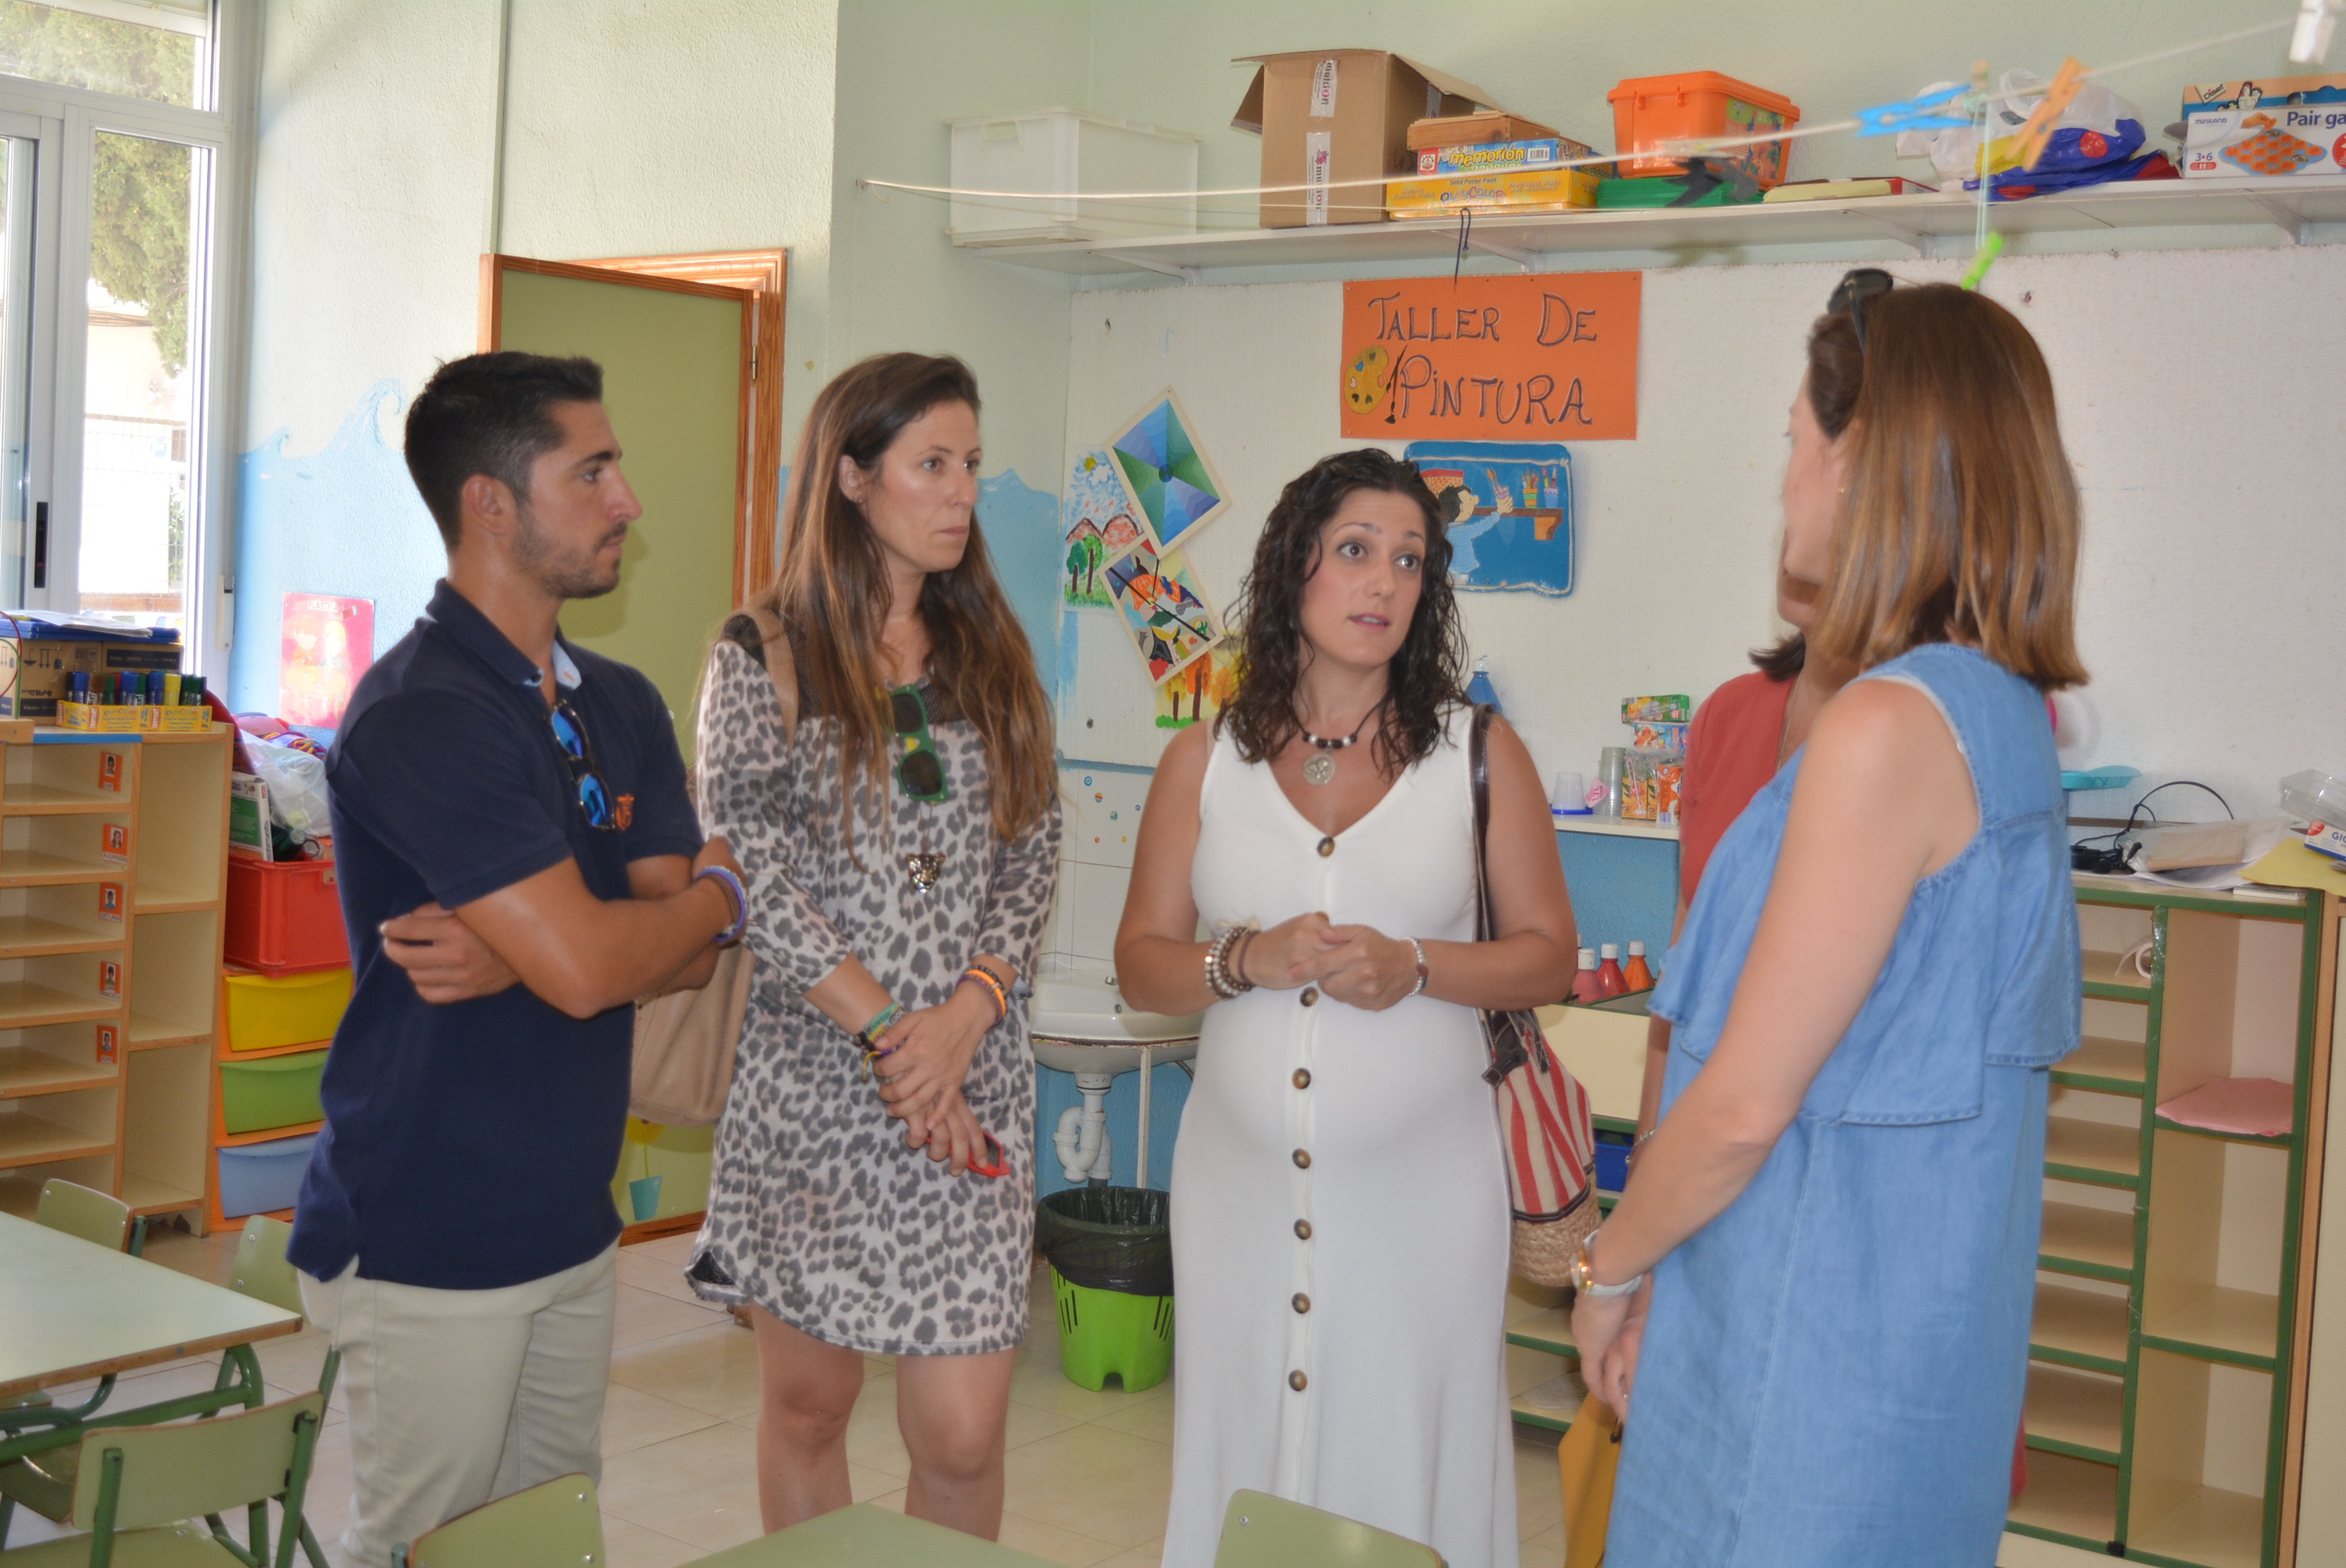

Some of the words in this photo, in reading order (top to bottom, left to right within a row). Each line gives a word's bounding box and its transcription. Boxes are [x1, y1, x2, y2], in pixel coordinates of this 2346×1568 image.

[2203, 83, 2225, 100] Diset
[2286, 111, 2322, 126] Pair
[1449, 144, 1527, 167] memorión
[1367, 292, 1501, 343] TALLER
[1536, 292, 1598, 347] DE
[1400, 354, 1592, 426] PINTURA
